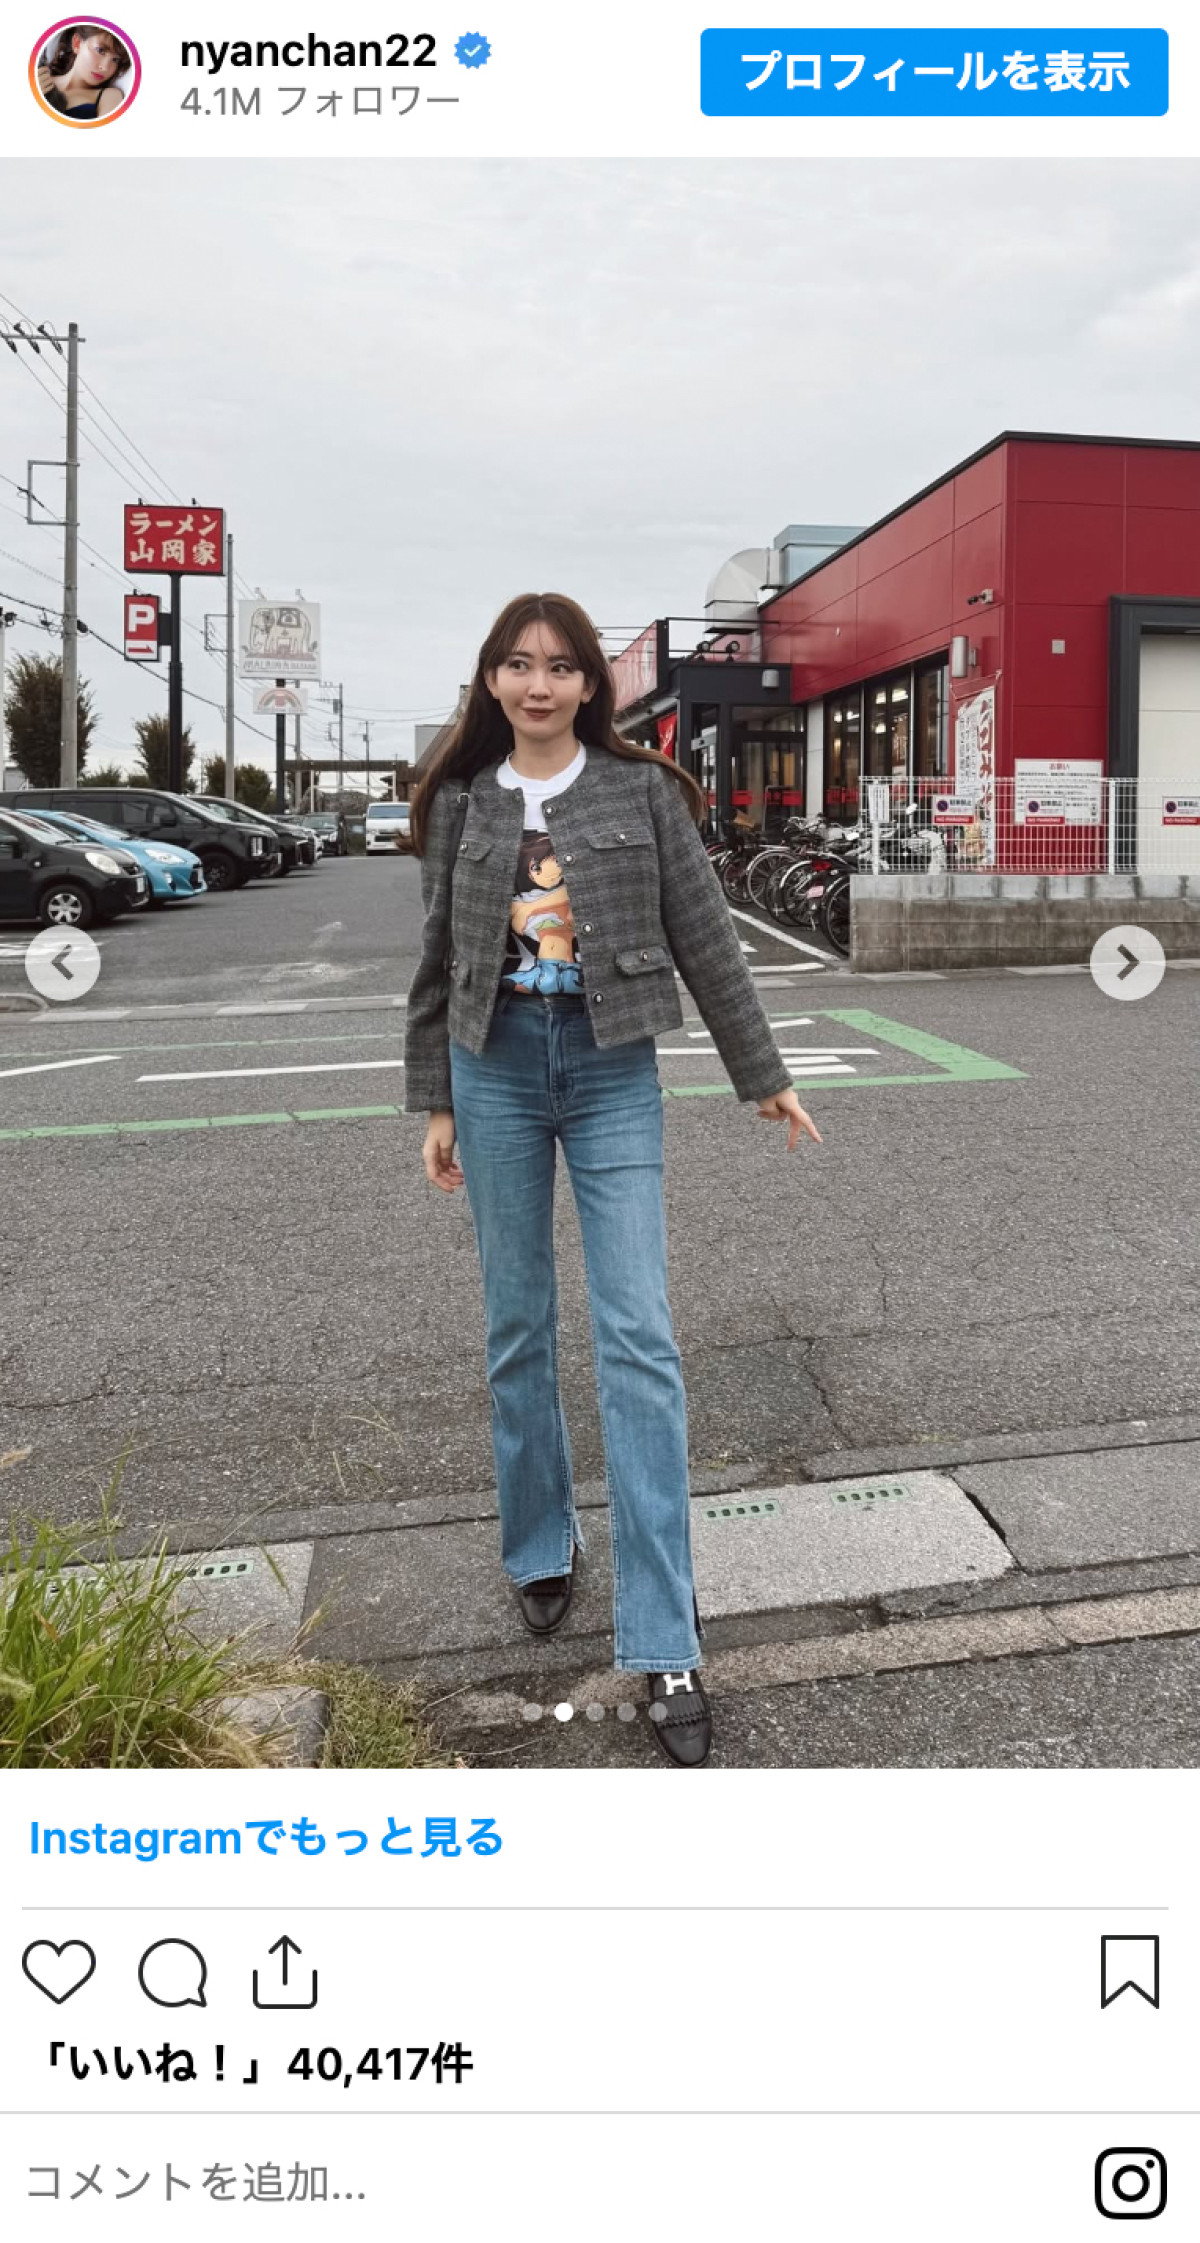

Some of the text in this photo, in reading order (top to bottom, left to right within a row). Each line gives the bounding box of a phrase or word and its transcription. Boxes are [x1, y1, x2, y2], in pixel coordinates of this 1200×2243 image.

[130, 511, 217, 537] ラーメン
[130, 537, 217, 566] 山岡家
[128, 604, 154, 632] P
[663, 1671, 693, 1695] H
